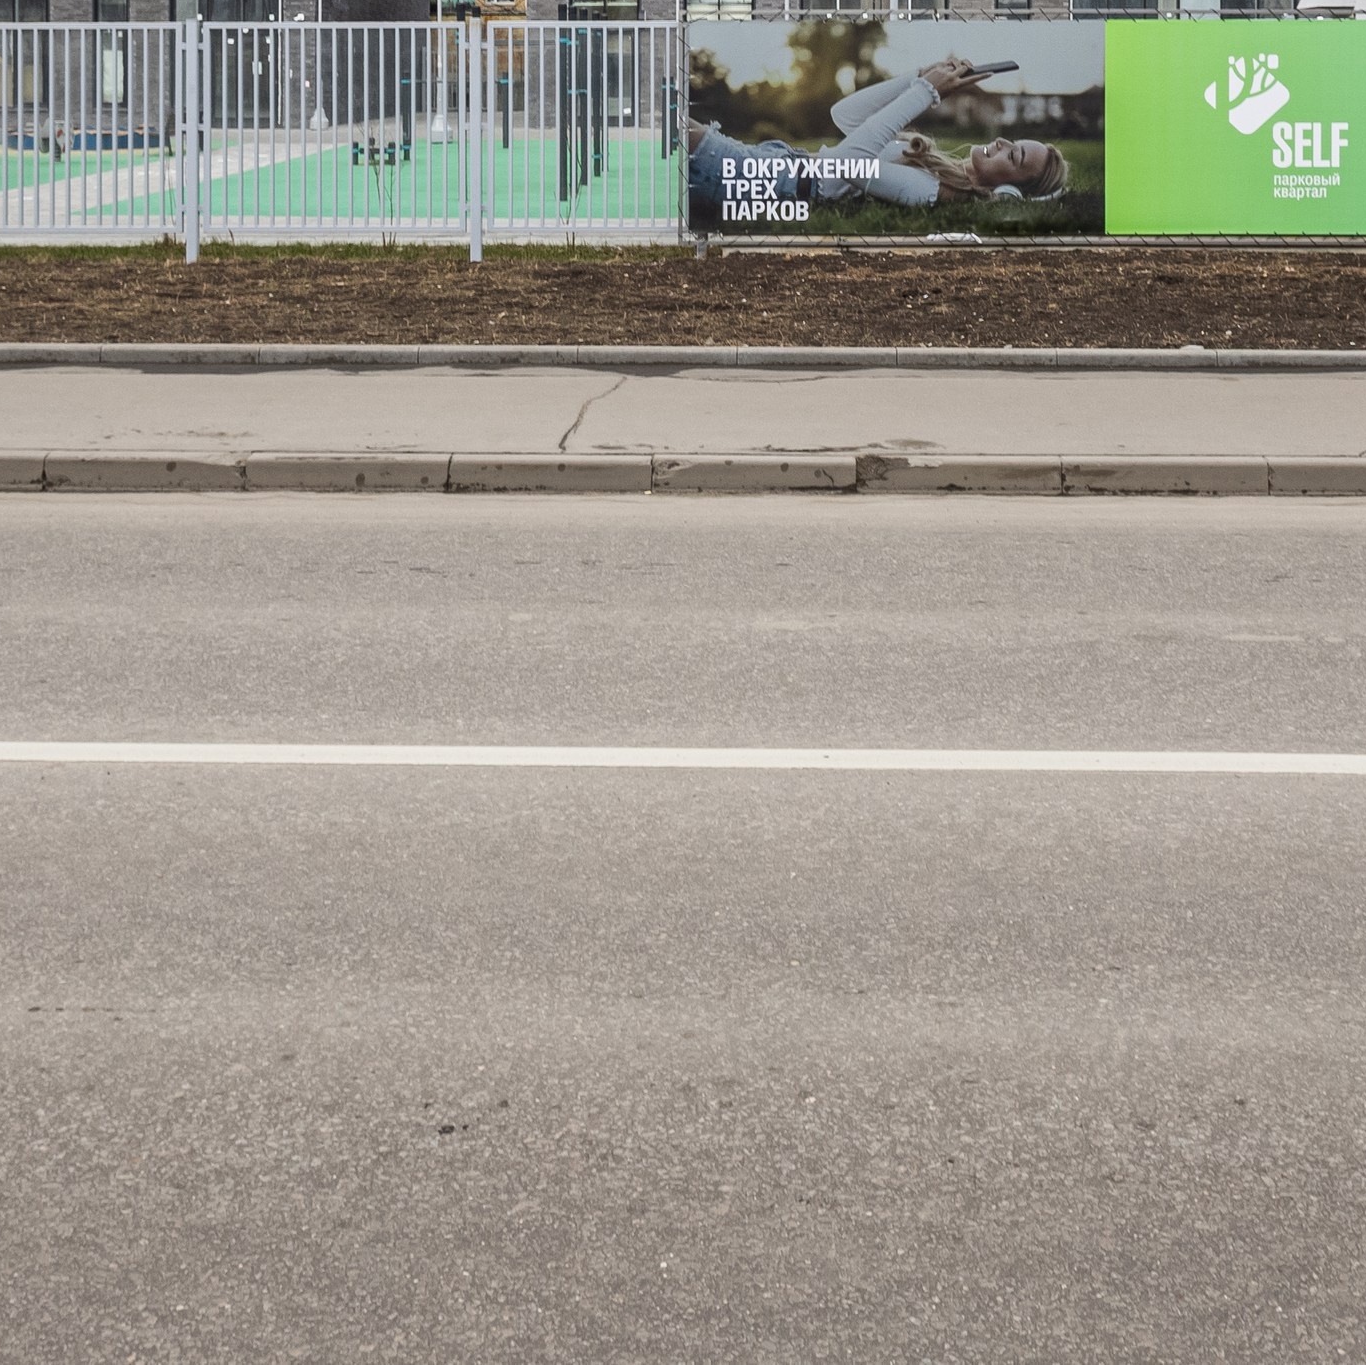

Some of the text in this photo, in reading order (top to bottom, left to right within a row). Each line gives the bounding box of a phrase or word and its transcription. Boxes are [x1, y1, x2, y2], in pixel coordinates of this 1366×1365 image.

[1272, 121, 1349, 168] SELF
[722, 158, 880, 179] В ОКРУЖЕНИИ
[722, 179, 777, 200] ТРЕХ
[1273, 173, 1341, 187] парковый
[1273, 187, 1327, 201] квартал
[722, 200, 810, 222] ПАРКОВ
